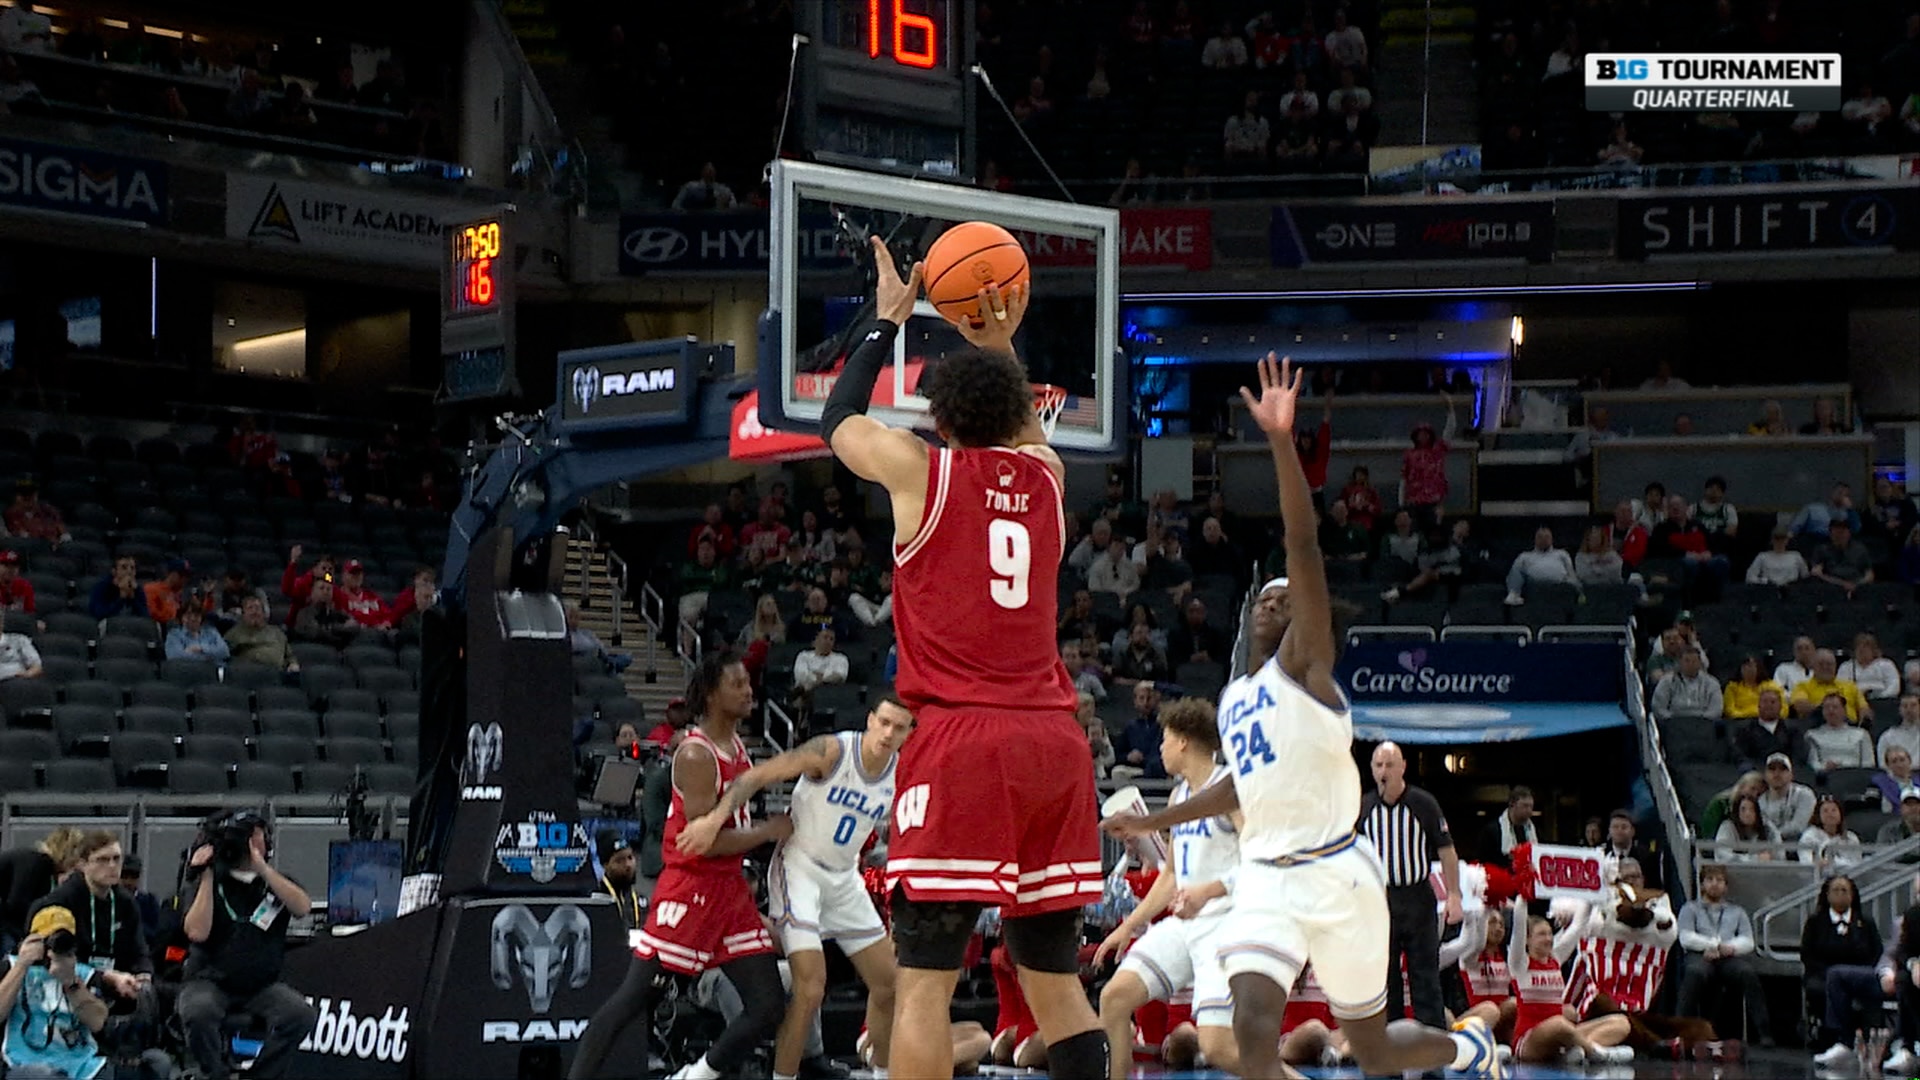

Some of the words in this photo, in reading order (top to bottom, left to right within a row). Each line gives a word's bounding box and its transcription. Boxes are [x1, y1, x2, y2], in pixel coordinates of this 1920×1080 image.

[867, 0, 937, 69] 16
[0, 148, 160, 215] SIGMA
[301, 200, 347, 224] LIFT
[352, 207, 450, 238] ACADEM
[1642, 200, 1829, 250] SHIFT
[1856, 202, 1877, 237] 4
[469, 258, 496, 306] 16
[602, 367, 676, 397] RAM
[985, 487, 1031, 514] TONJE
[988, 517, 1031, 610] 9
[1351, 666, 1512, 694] CareSource
[1231, 720, 1276, 776] 24
[827, 786, 885, 820] UCLA
[896, 783, 930, 836] W
[833, 815, 857, 846] 0
[1181, 841, 1189, 876] 1
[655, 899, 689, 930] W
[482, 1018, 590, 1044] RAM
